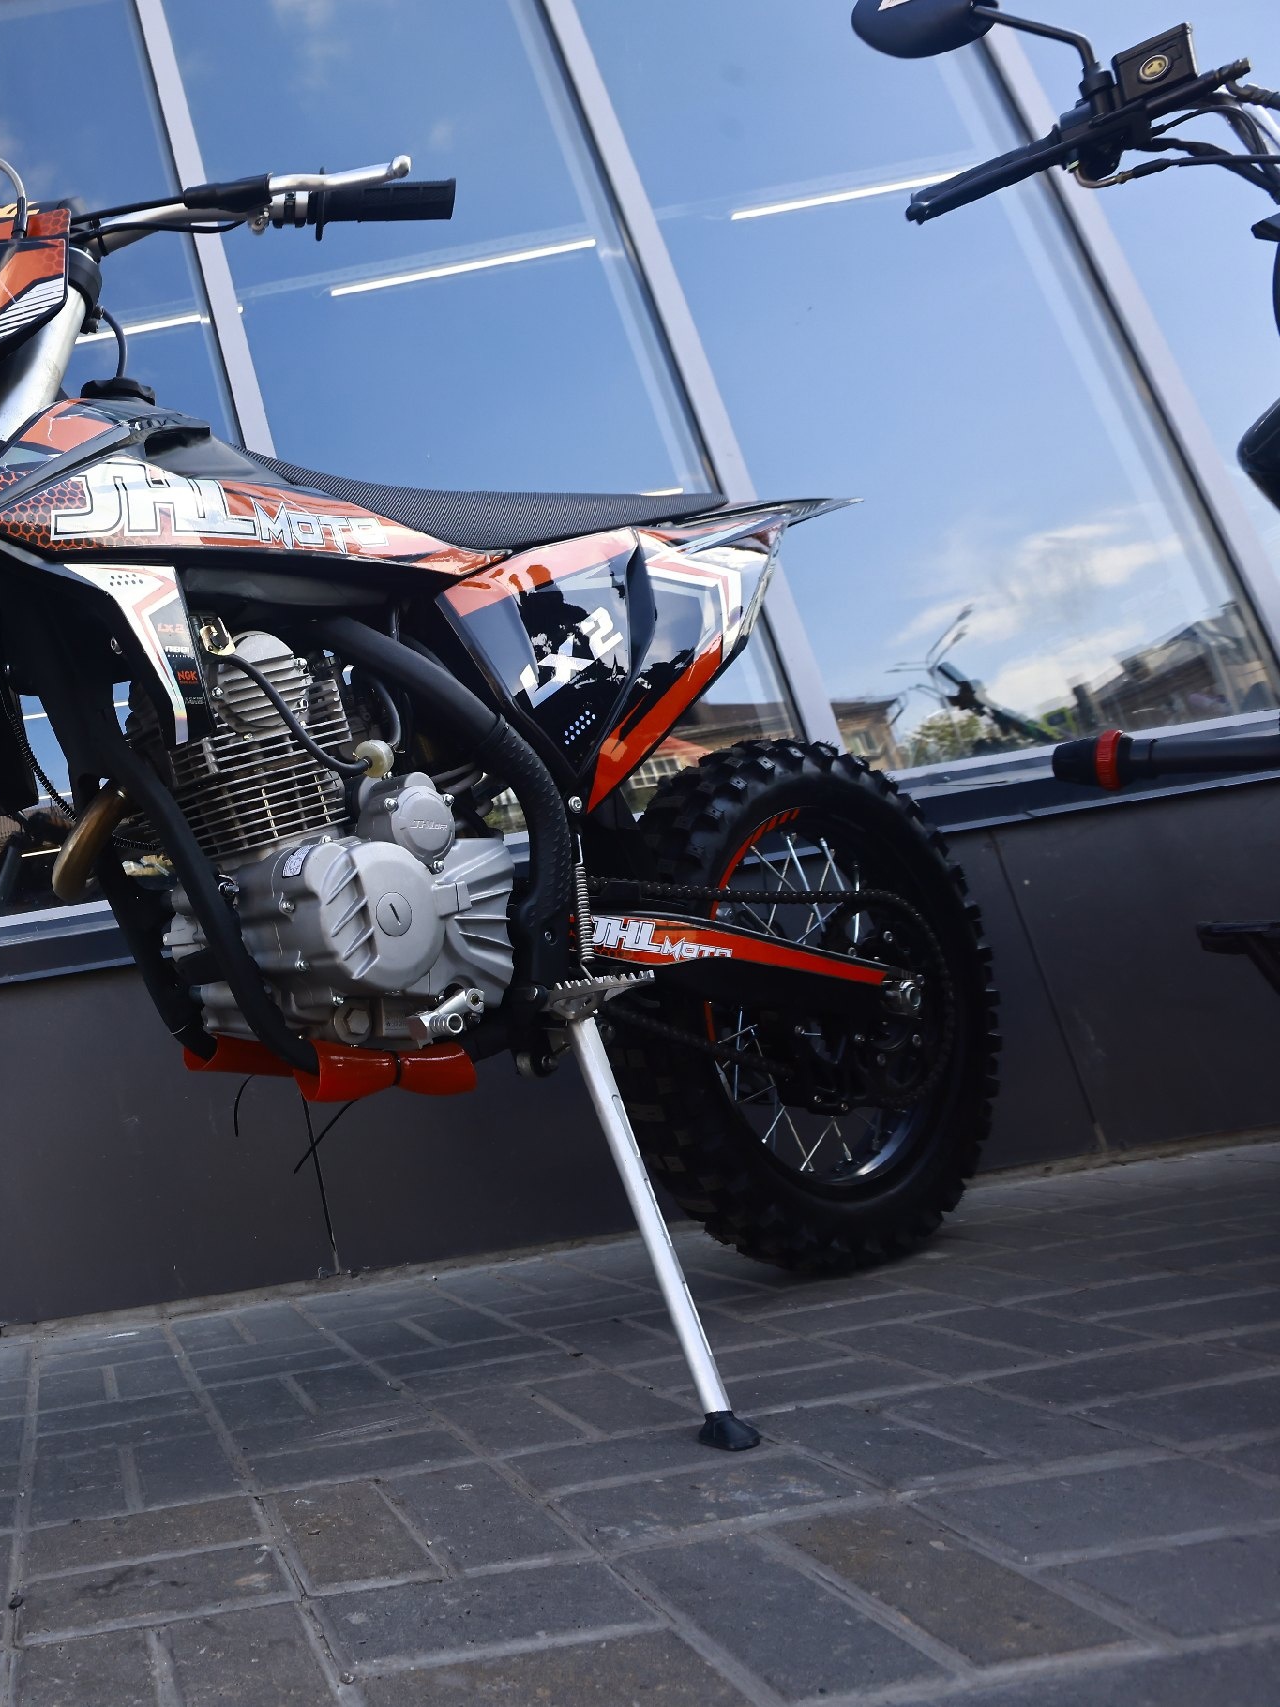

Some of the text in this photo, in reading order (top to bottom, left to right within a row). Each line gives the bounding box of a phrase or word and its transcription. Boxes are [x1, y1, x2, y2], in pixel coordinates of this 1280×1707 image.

[51, 462, 390, 553] JHL MOTO
[177, 670, 198, 681] NGK
